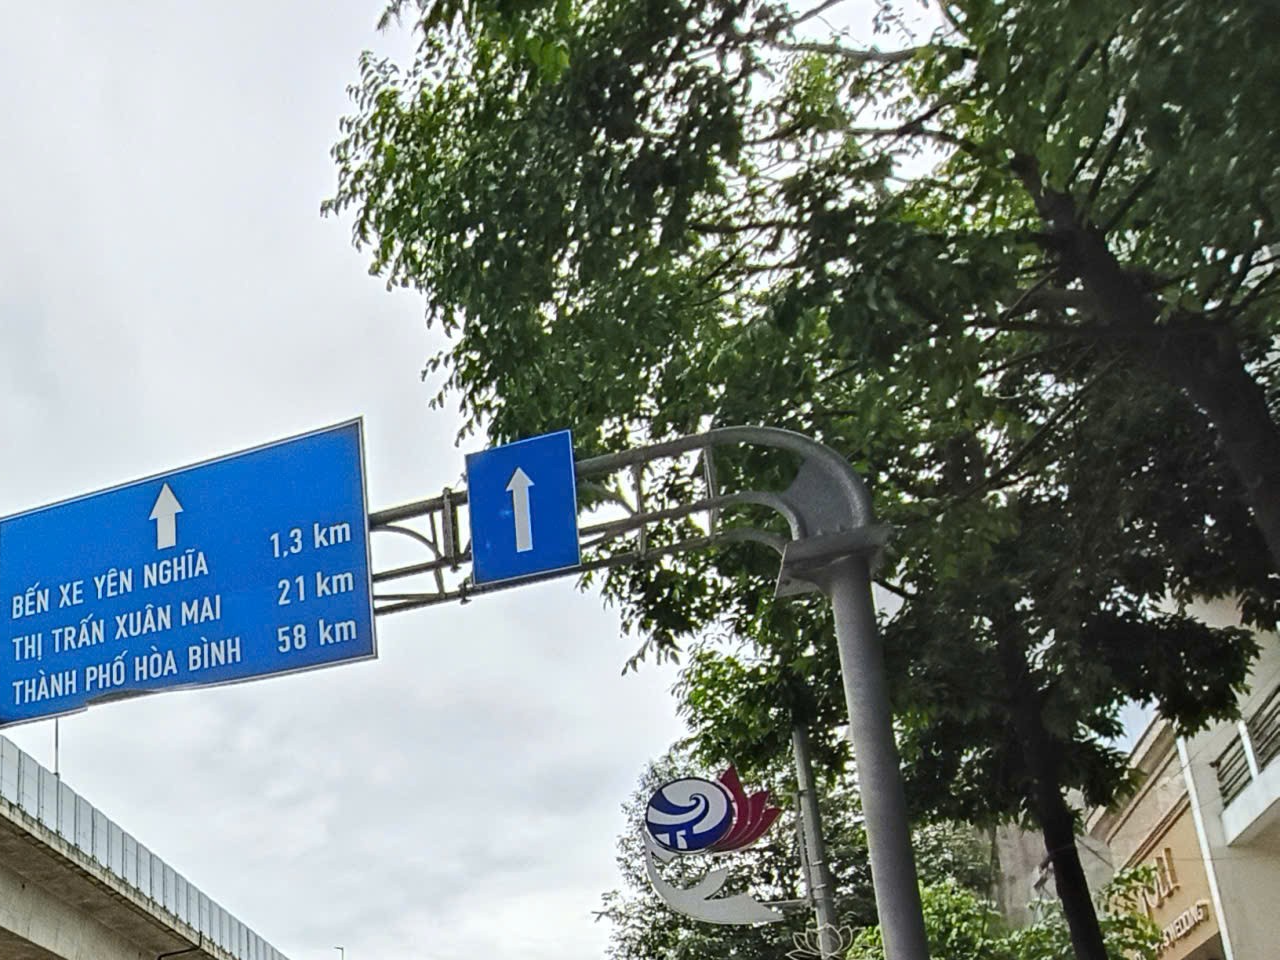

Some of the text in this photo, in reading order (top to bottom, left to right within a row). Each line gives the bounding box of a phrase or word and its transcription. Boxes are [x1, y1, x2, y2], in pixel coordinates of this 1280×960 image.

[12, 521, 351, 620] BẾN XE YÊN NGHĨA 1,3 km
[13, 570, 354, 662] THỊ TRẤN XUÂN MAI 21 km
[13, 618, 357, 706] THÀNH PHỐ HÒA BÌNH 58 km
